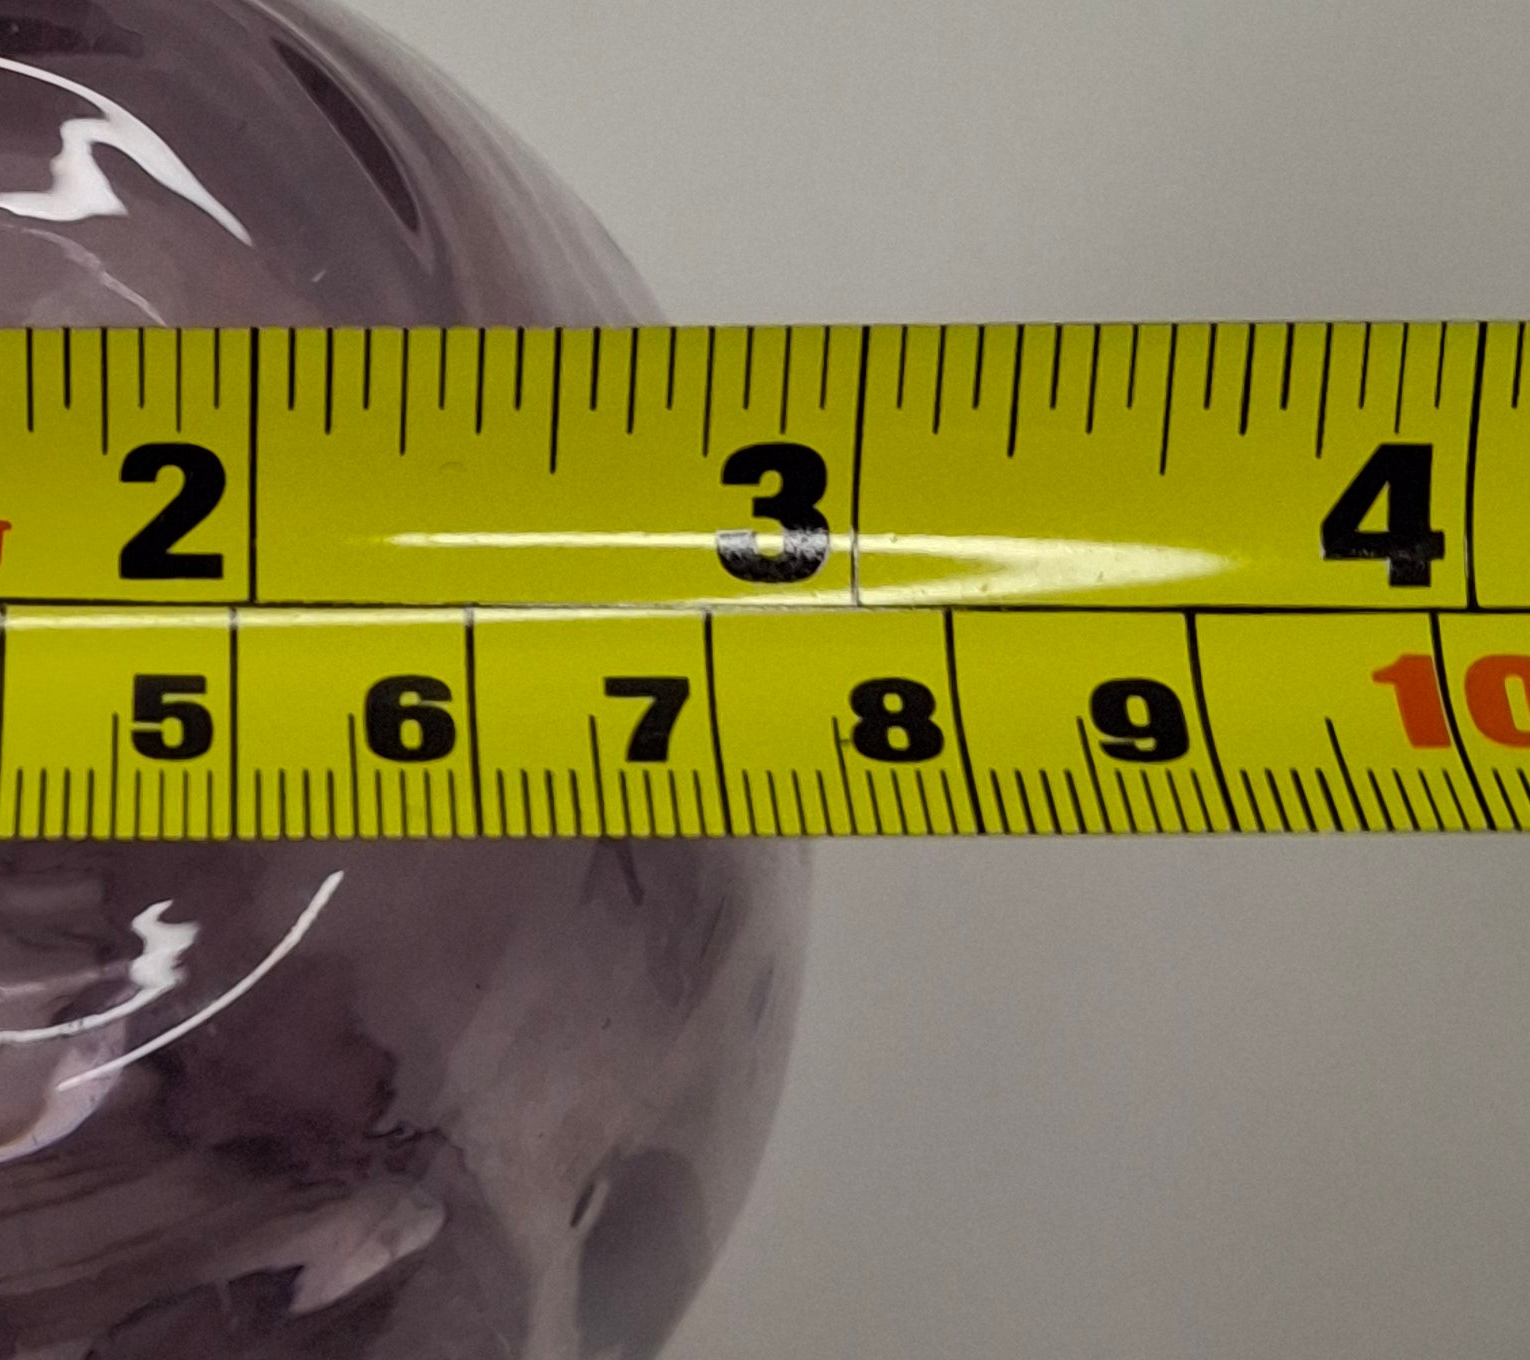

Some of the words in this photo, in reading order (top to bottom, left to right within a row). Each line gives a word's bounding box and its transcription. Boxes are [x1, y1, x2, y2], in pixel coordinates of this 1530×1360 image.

[118, 442, 227, 580] 2
[716, 442, 831, 584] 3
[1320, 443, 1446, 588] 4
[130, 674, 214, 761] 5
[363, 675, 457, 763] 6
[603, 676, 691, 763] 7
[847, 677, 945, 763] 8
[1088, 678, 1190, 764] 9
[1371, 653, 1530, 750] 10
